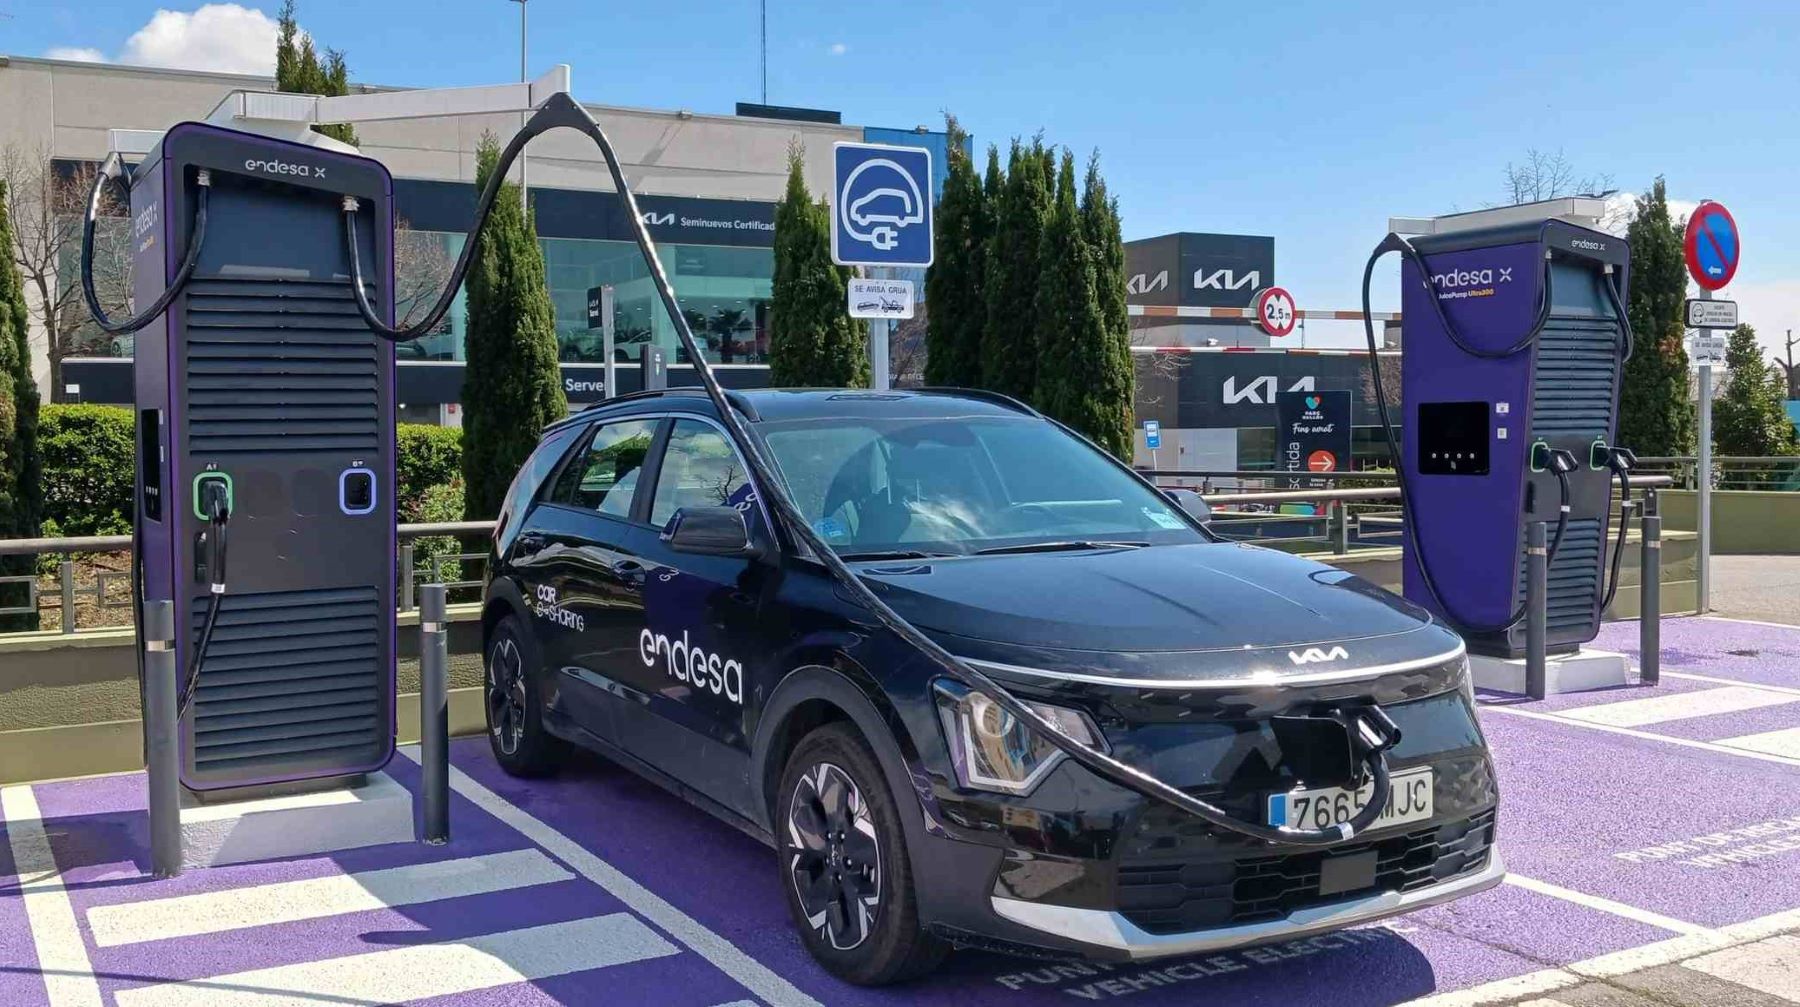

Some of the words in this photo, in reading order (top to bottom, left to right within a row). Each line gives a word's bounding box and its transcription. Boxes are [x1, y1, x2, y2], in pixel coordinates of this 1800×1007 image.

[245, 159, 309, 176] endesa
[680, 217, 732, 229] Seminuevos
[1571, 239, 1599, 250] endesa
[1193, 268, 1260, 290] KIA
[854, 285, 864, 293] SE
[866, 286, 886, 294] AVISA
[565, 378, 606, 391] Serve
[640, 628, 744, 705] endesa
[1064, 955, 1248, 1000] VEHICLE
